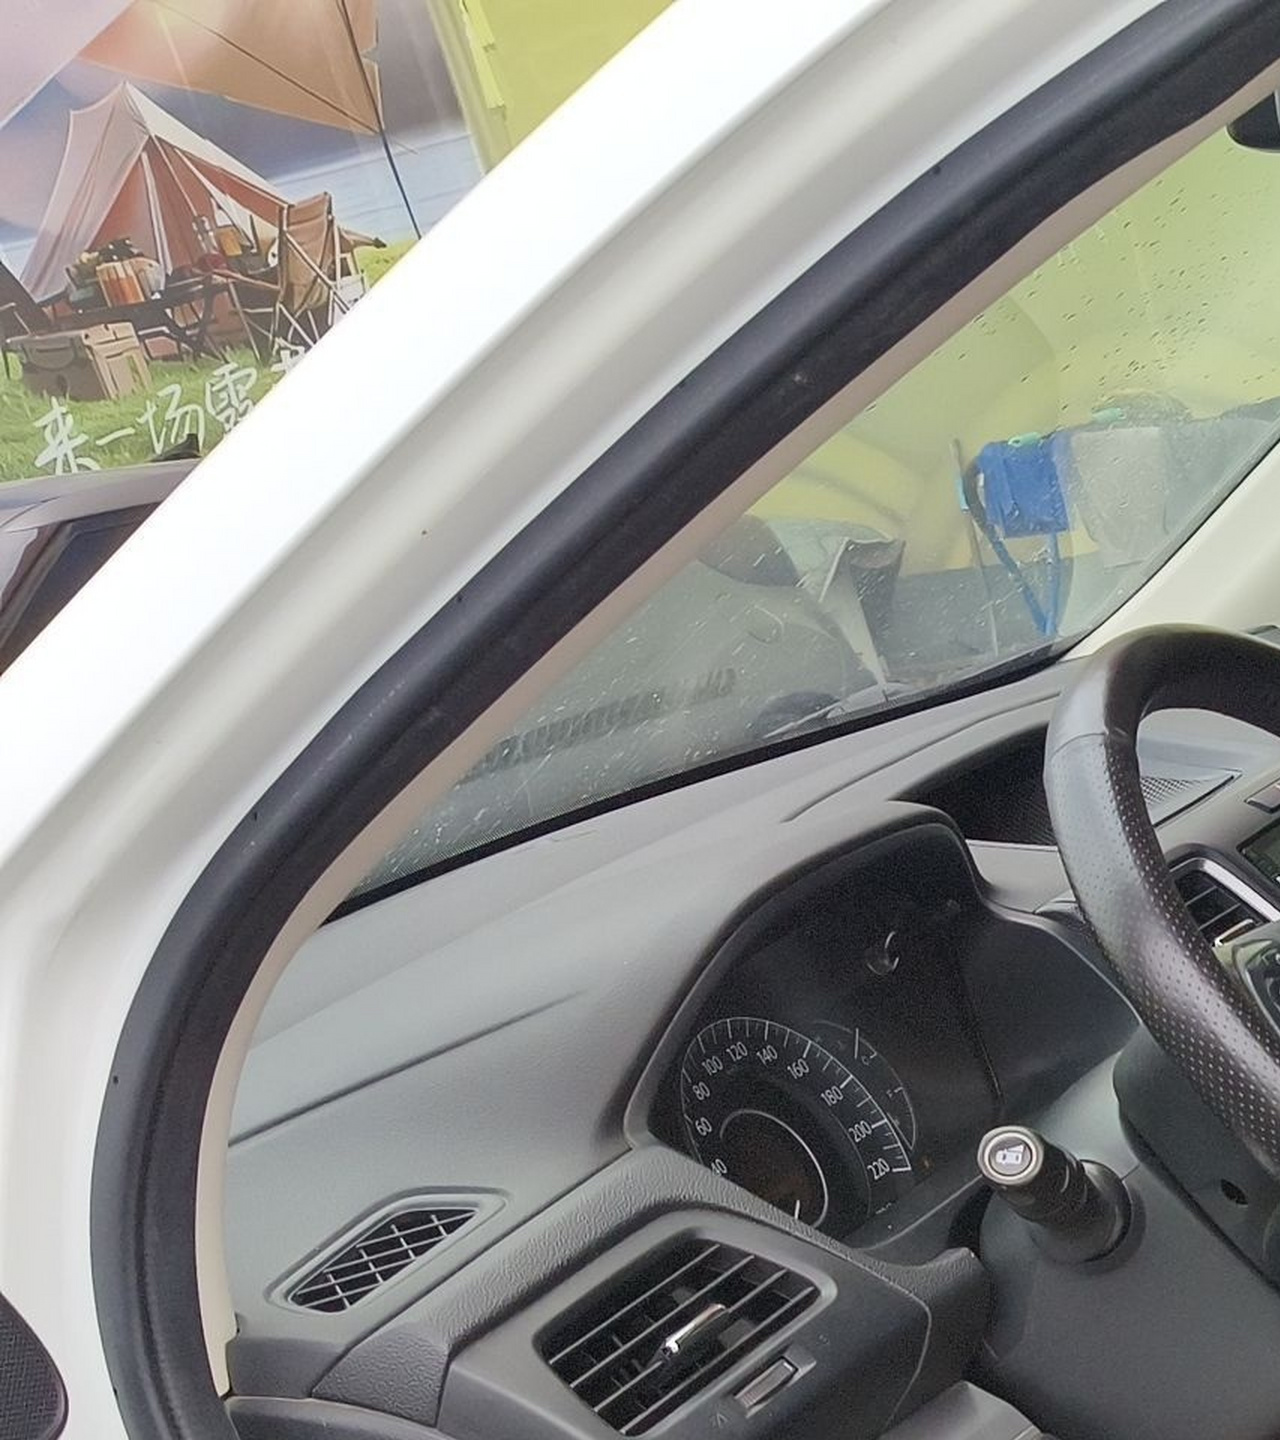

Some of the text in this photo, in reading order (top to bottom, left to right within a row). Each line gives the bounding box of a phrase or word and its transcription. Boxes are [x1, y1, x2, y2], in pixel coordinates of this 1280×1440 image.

[726, 1041, 748, 1062] 120
[756, 1044, 778, 1065] 140
[701, 1055, 723, 1077] 100
[787, 1057, 810, 1080] 160
[692, 1081, 711, 1101] 80
[820, 1085, 844, 1107] 180
[694, 1117, 713, 1137] 60
[848, 1120, 872, 1143] 200
[866, 1157, 891, 1181] 220
